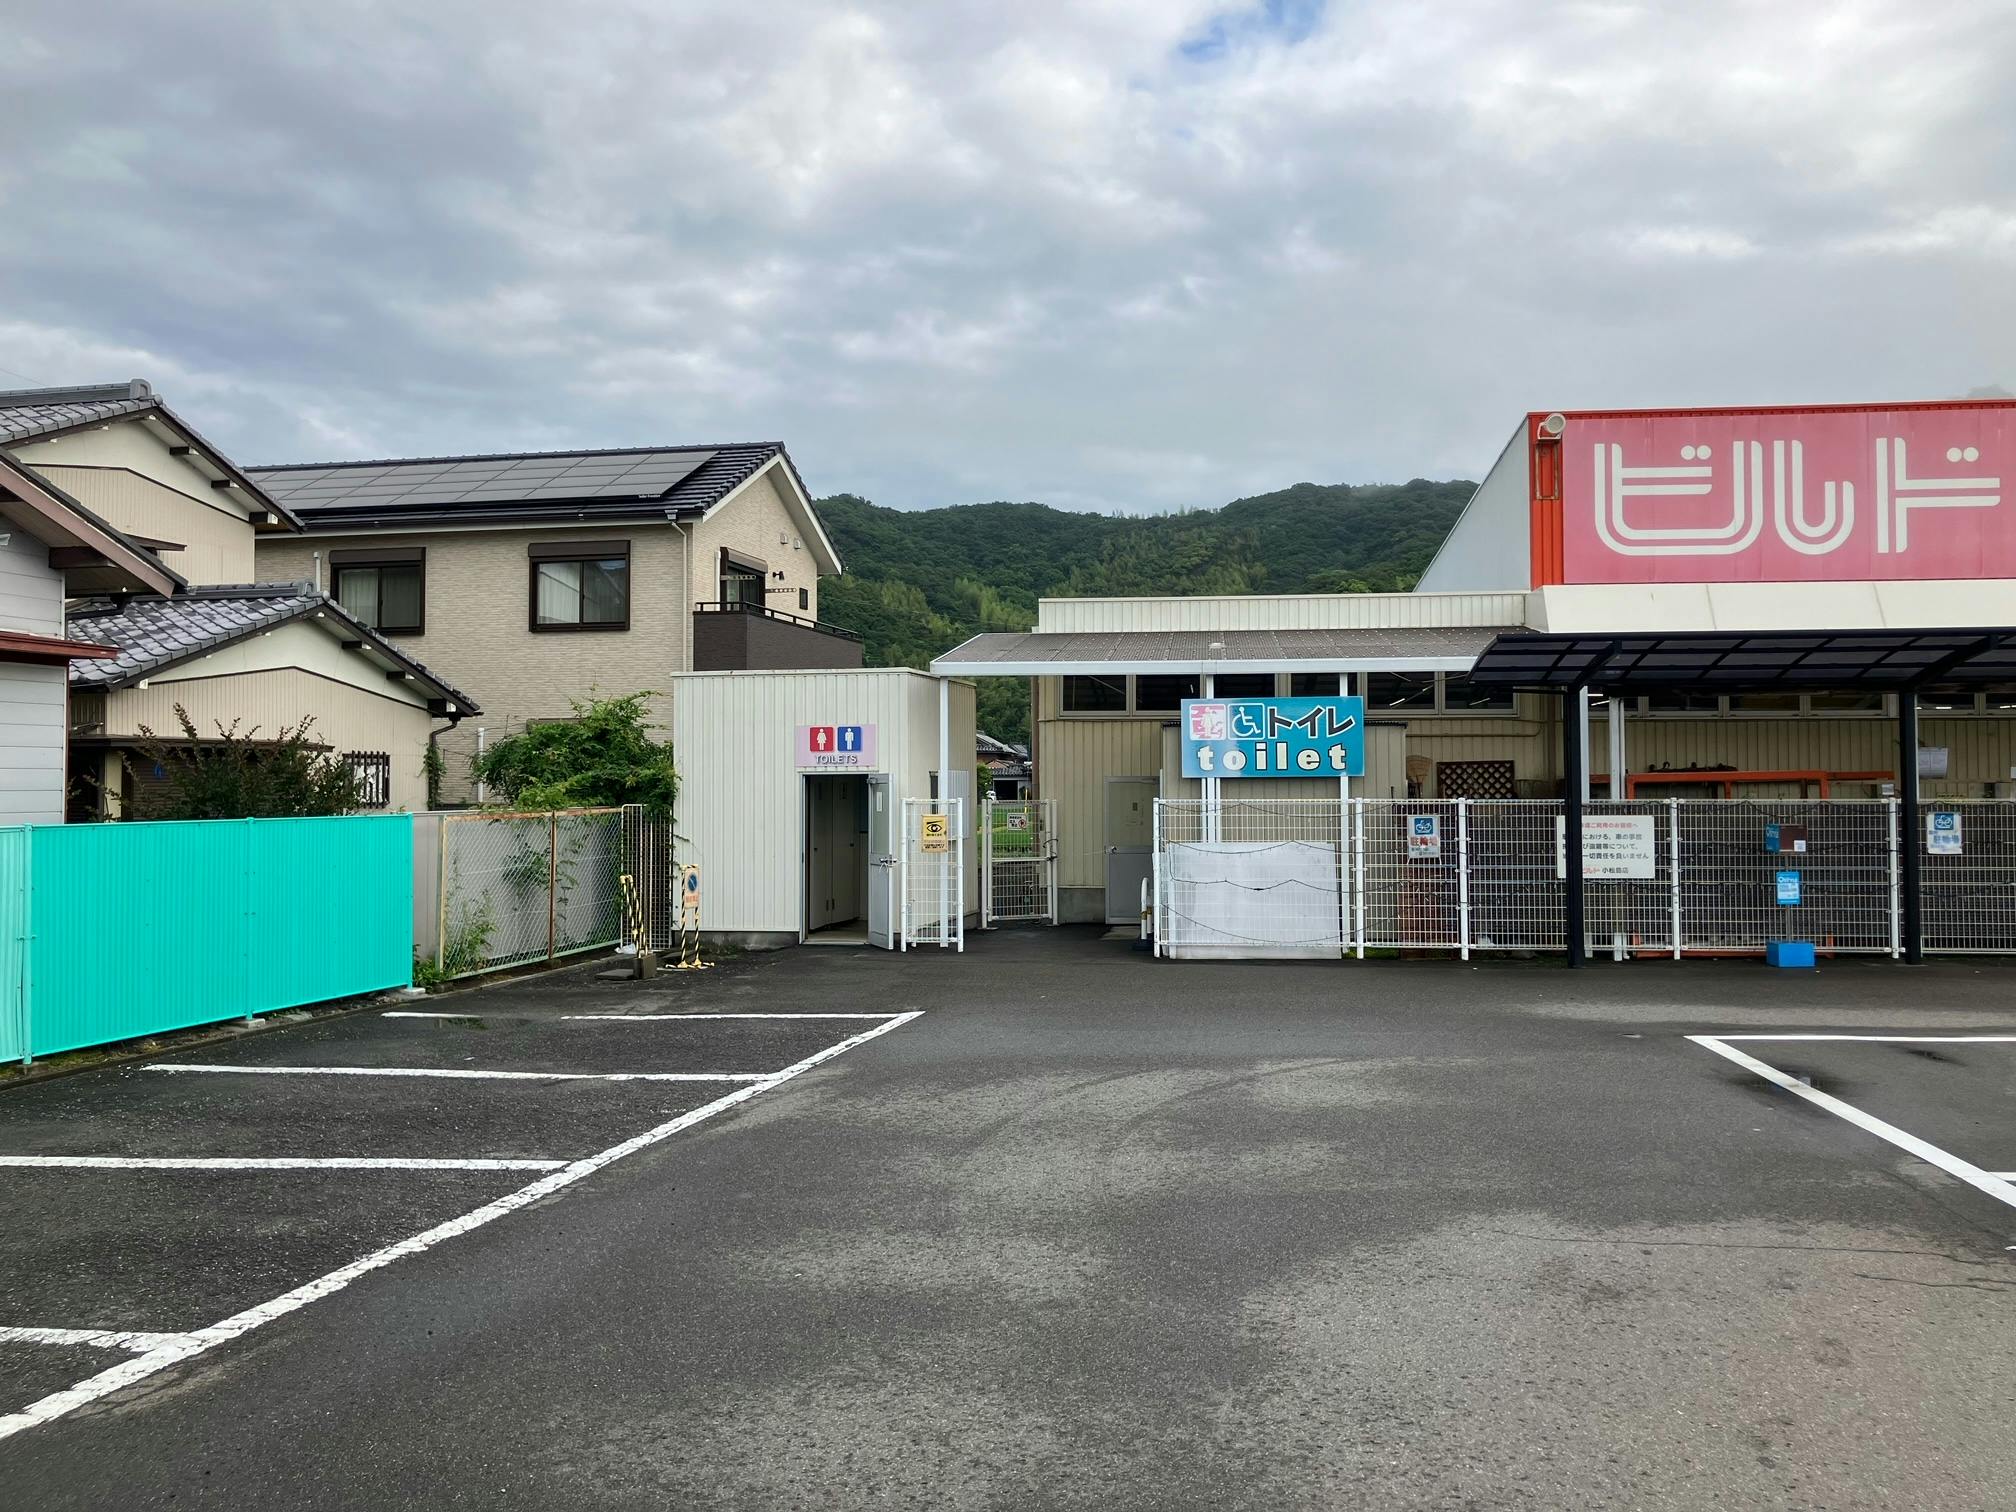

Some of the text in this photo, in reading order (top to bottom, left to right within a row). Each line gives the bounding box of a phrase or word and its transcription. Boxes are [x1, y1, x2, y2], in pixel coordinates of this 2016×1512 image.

[1594, 437, 2000, 556] ビルド
[1267, 705, 1356, 739] トイレ
[815, 754, 858, 765] TOILETS
[1197, 741, 1347, 771] toilet
